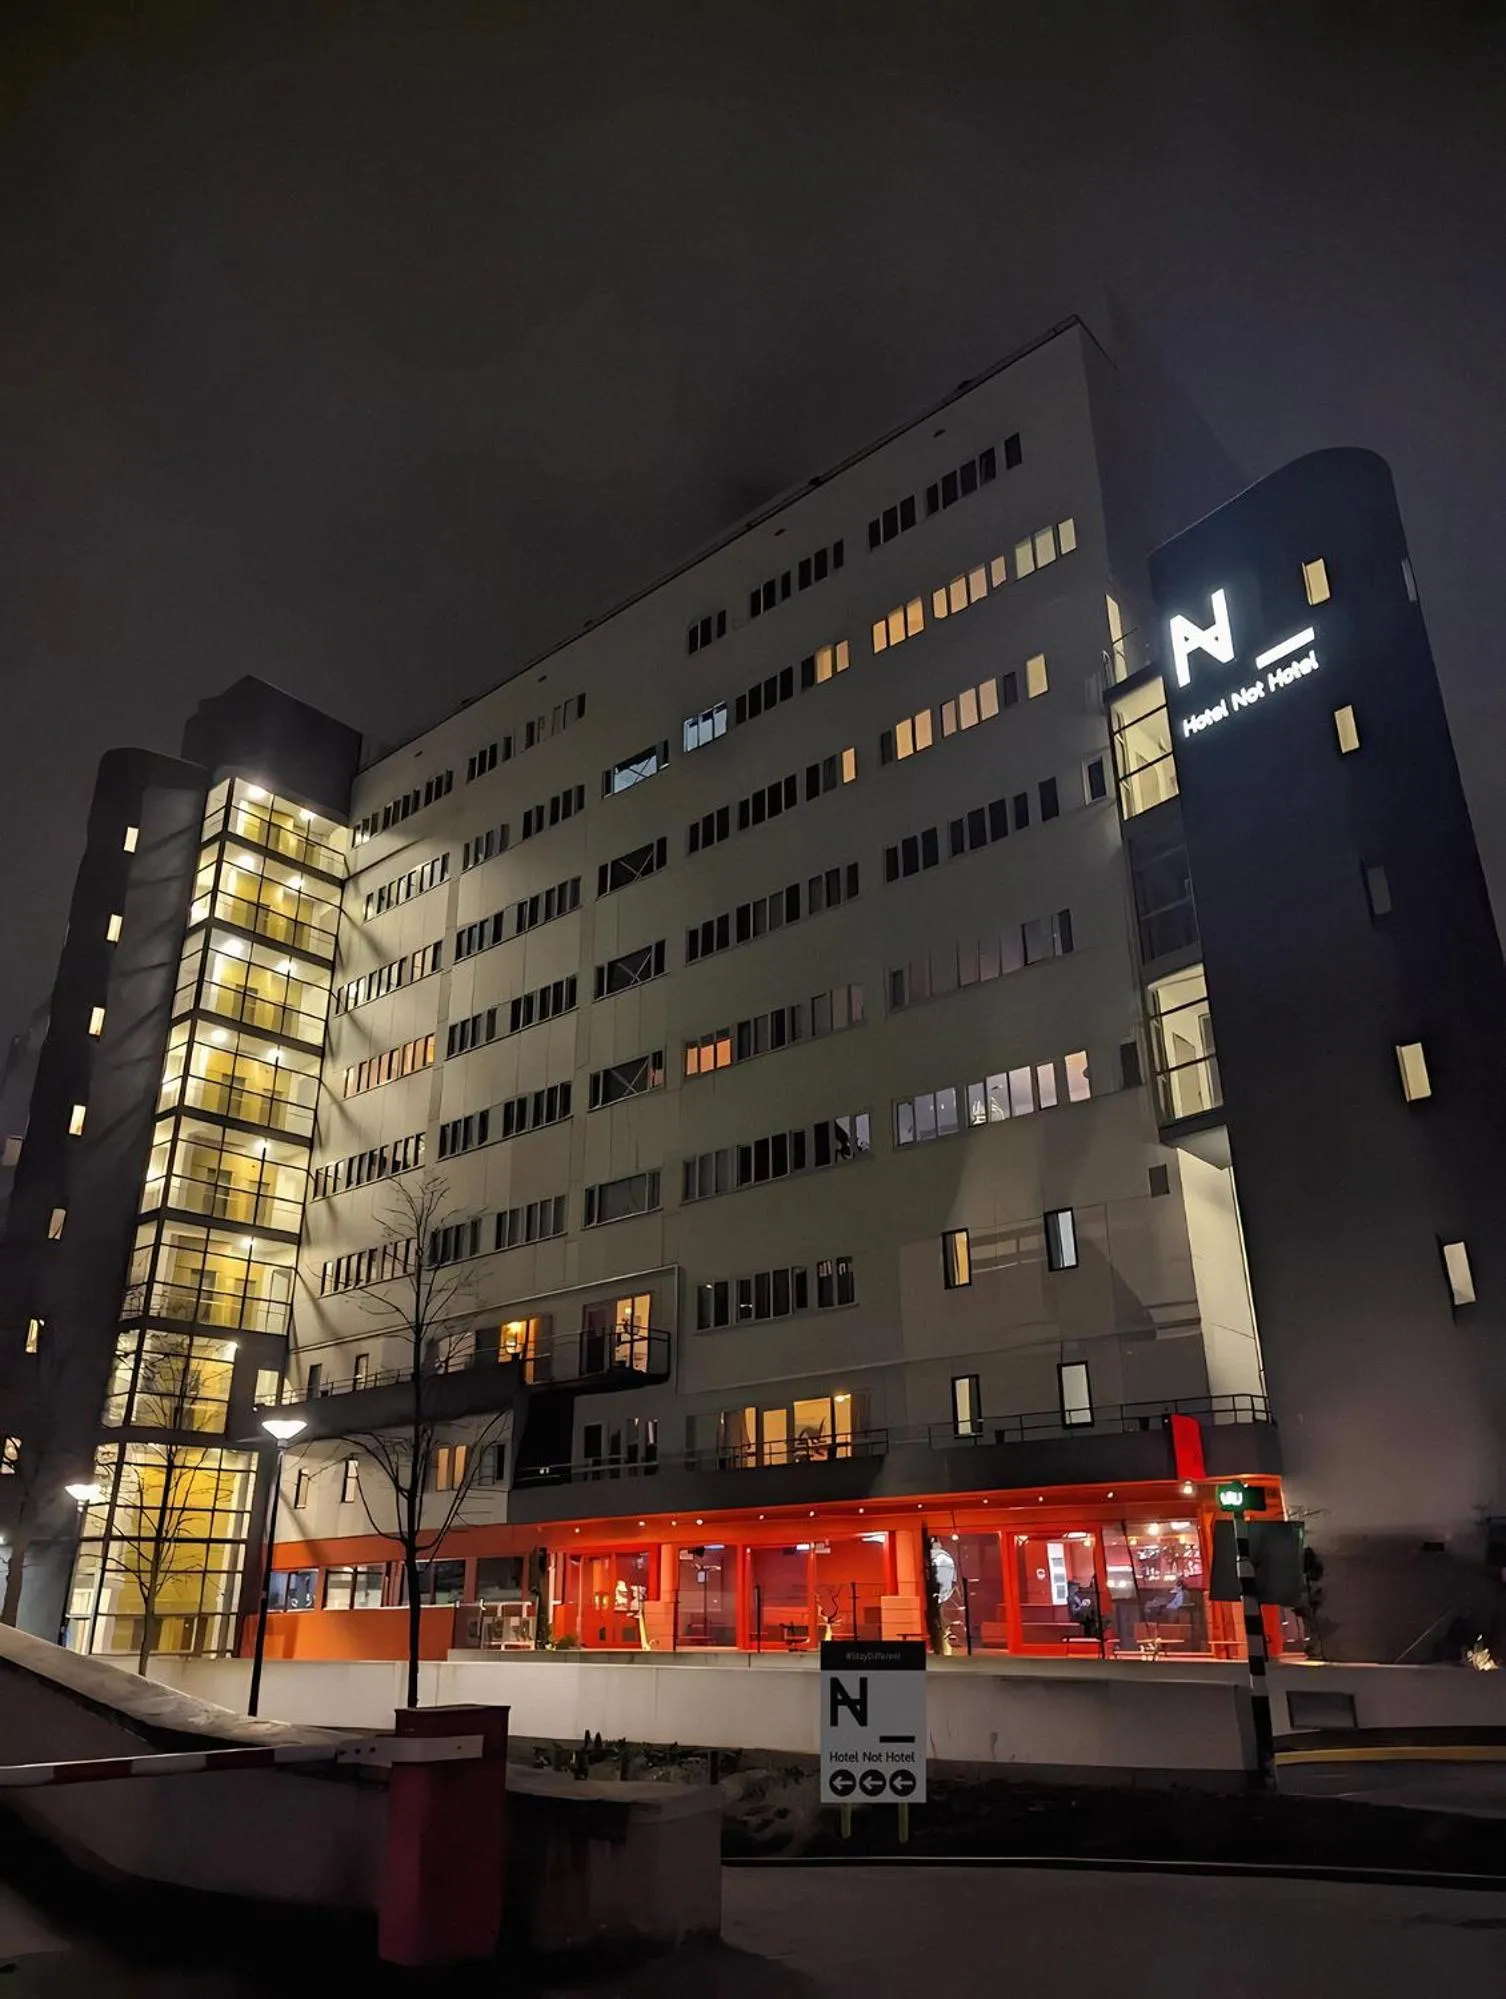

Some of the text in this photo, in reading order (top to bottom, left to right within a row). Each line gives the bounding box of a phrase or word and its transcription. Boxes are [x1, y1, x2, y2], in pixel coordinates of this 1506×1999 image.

[1183, 650, 1319, 738] Hotel Not Hotel
[830, 1752, 915, 1763] Hotel Not Hotel
